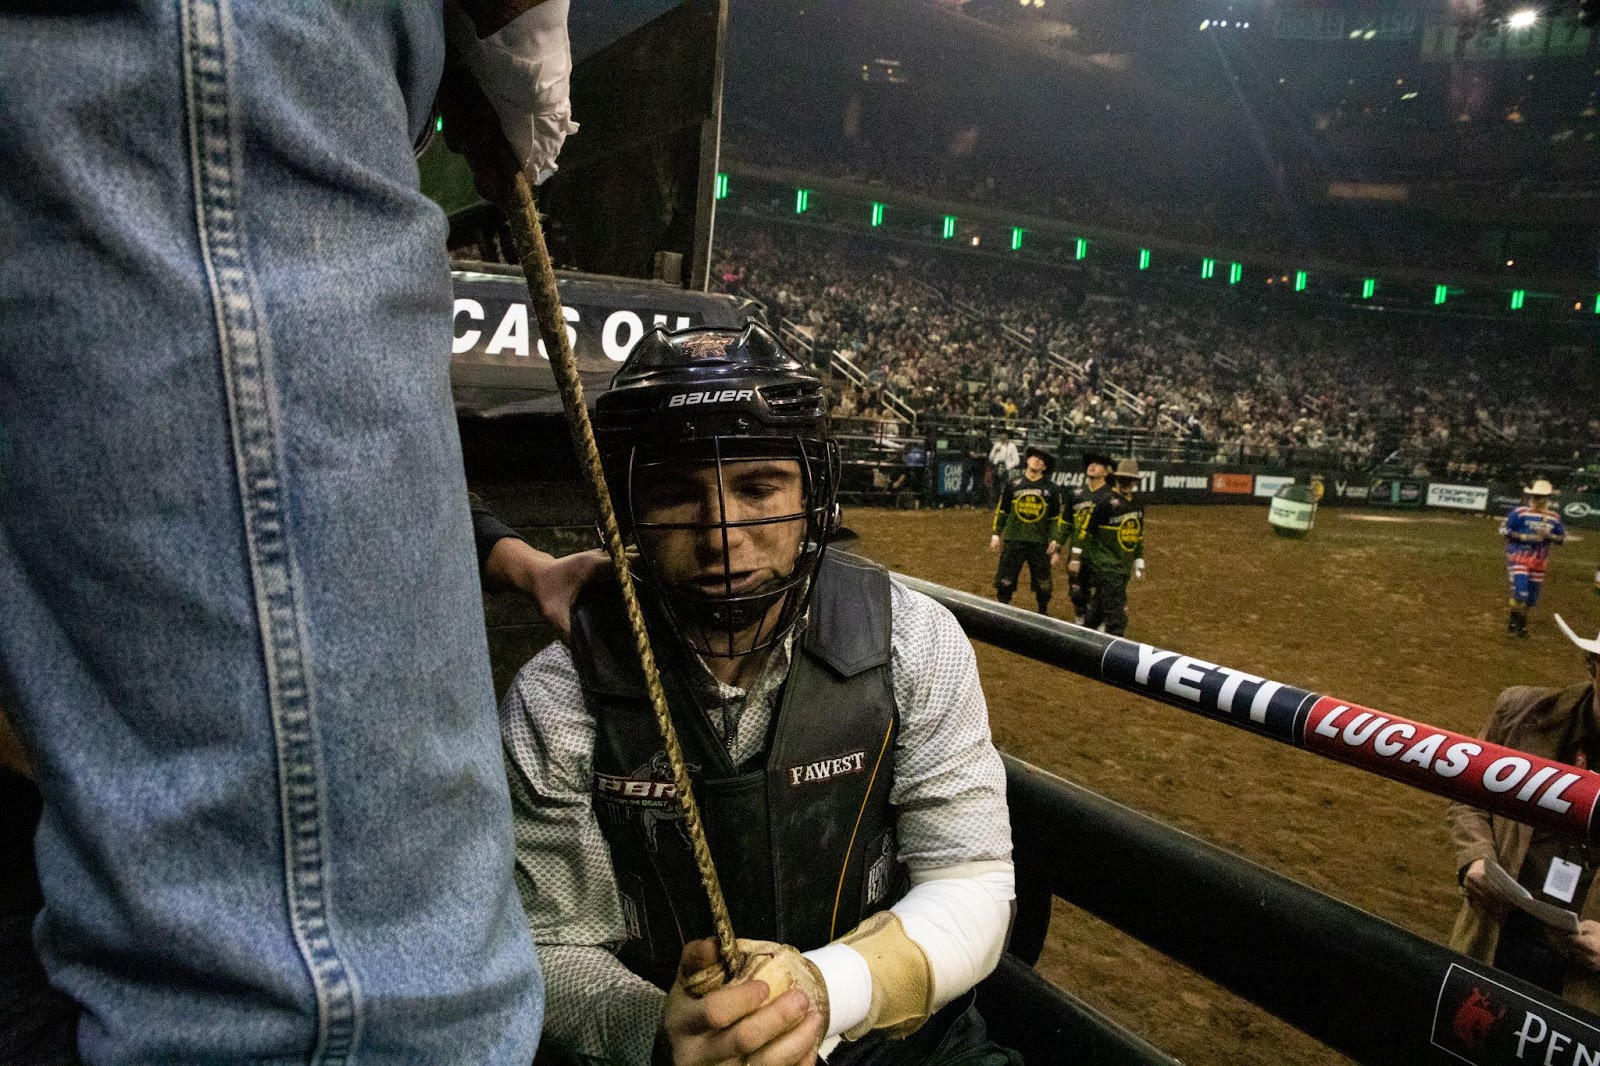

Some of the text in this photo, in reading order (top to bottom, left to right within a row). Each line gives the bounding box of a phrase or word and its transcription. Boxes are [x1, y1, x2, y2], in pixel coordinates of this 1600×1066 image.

[452, 299, 580, 356] CAS
[668, 388, 753, 408] BAUER
[1432, 486, 1487, 498] COOPER
[1438, 495, 1476, 504] TIRES
[1134, 643, 1285, 724] YETI
[790, 752, 865, 786] FAWEST
[1314, 705, 1582, 814] LUCAS OIL
